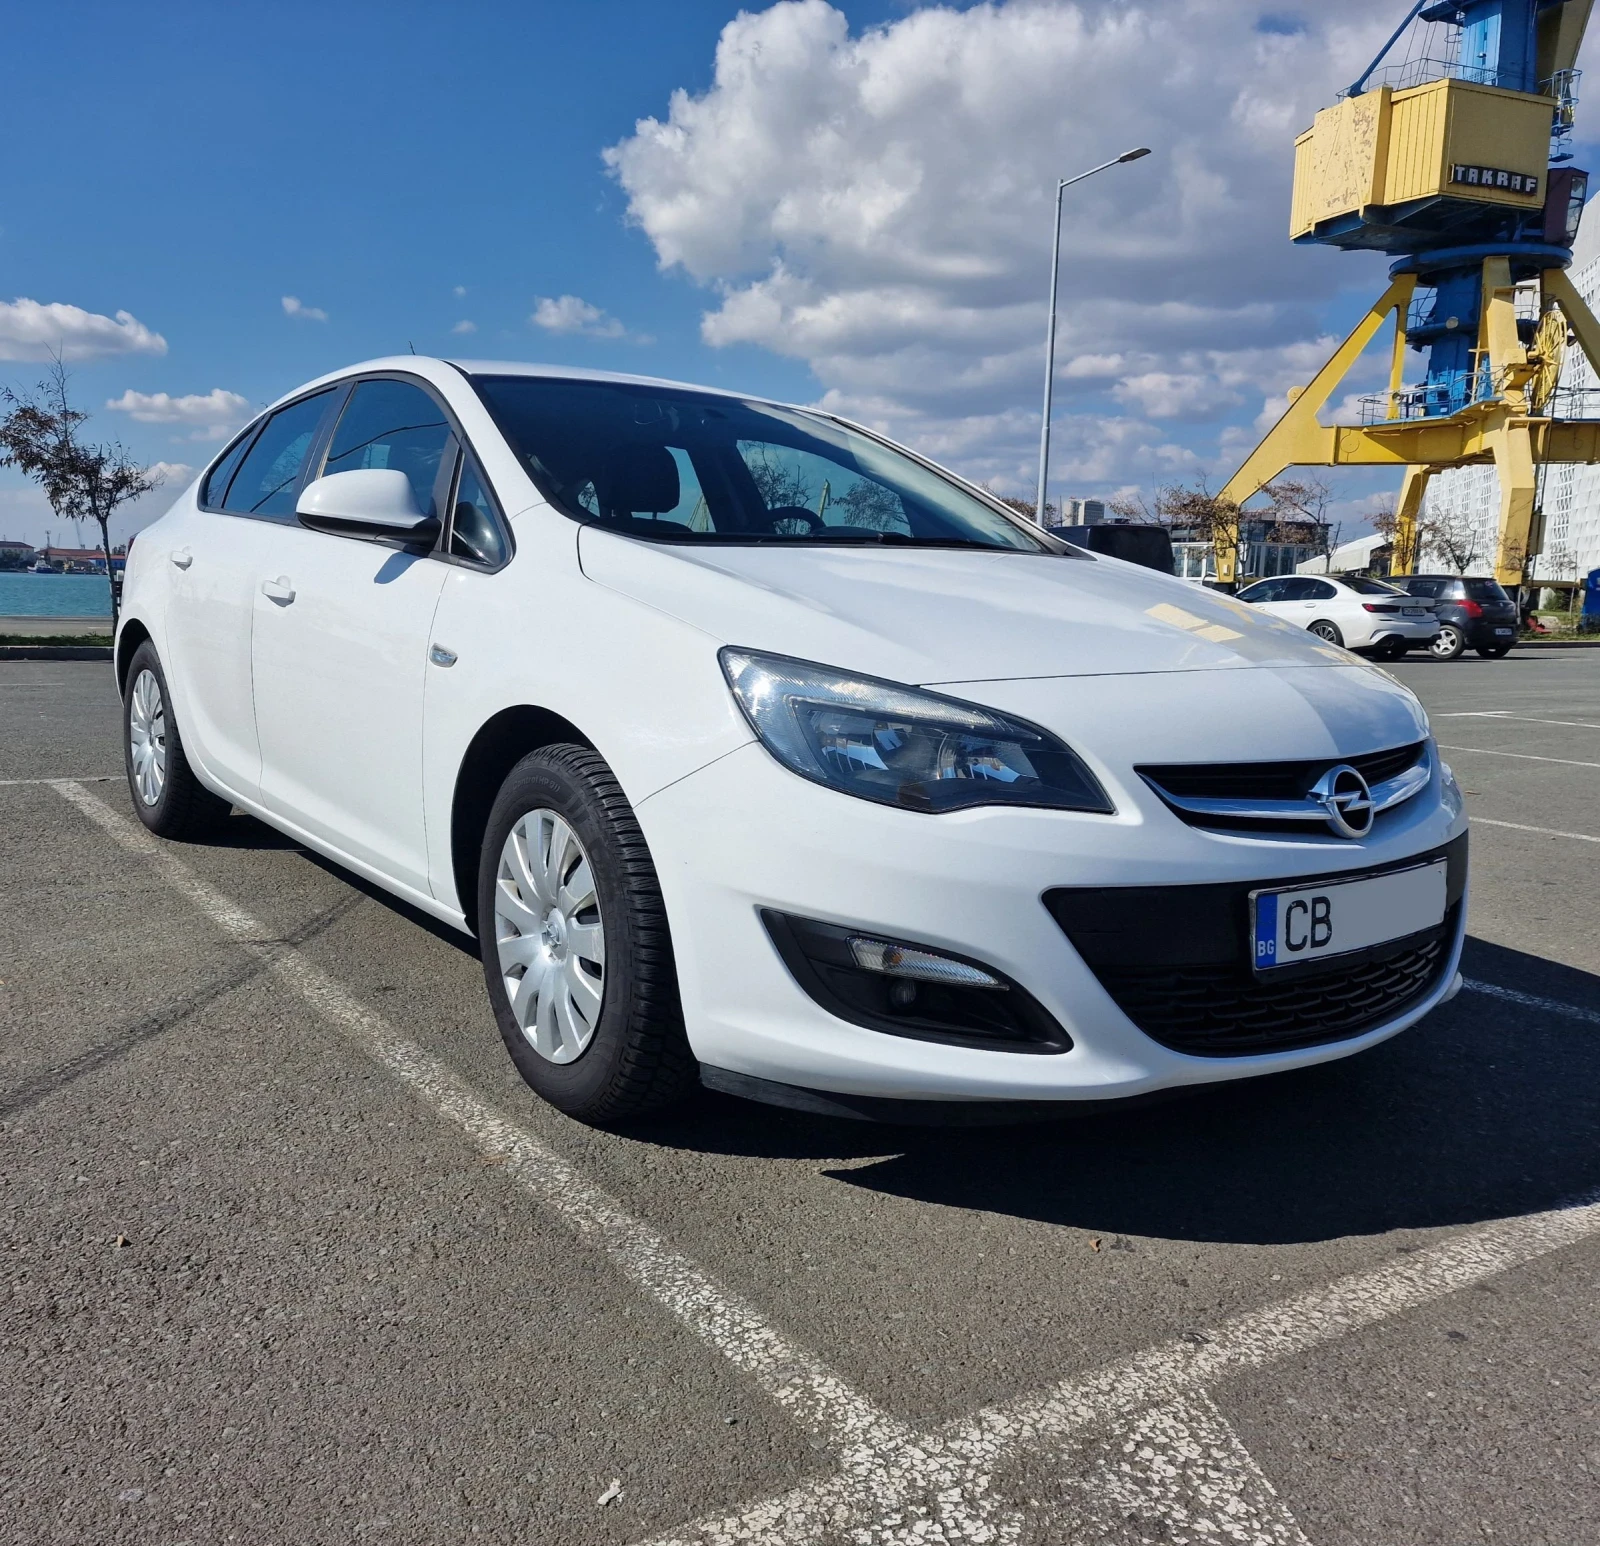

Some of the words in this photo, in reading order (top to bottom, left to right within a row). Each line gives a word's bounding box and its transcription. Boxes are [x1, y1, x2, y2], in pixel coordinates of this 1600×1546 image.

[1455, 166, 1538, 193] TAKRAF
[1285, 896, 1333, 952] CB
[1257, 940, 1275, 957] BG
